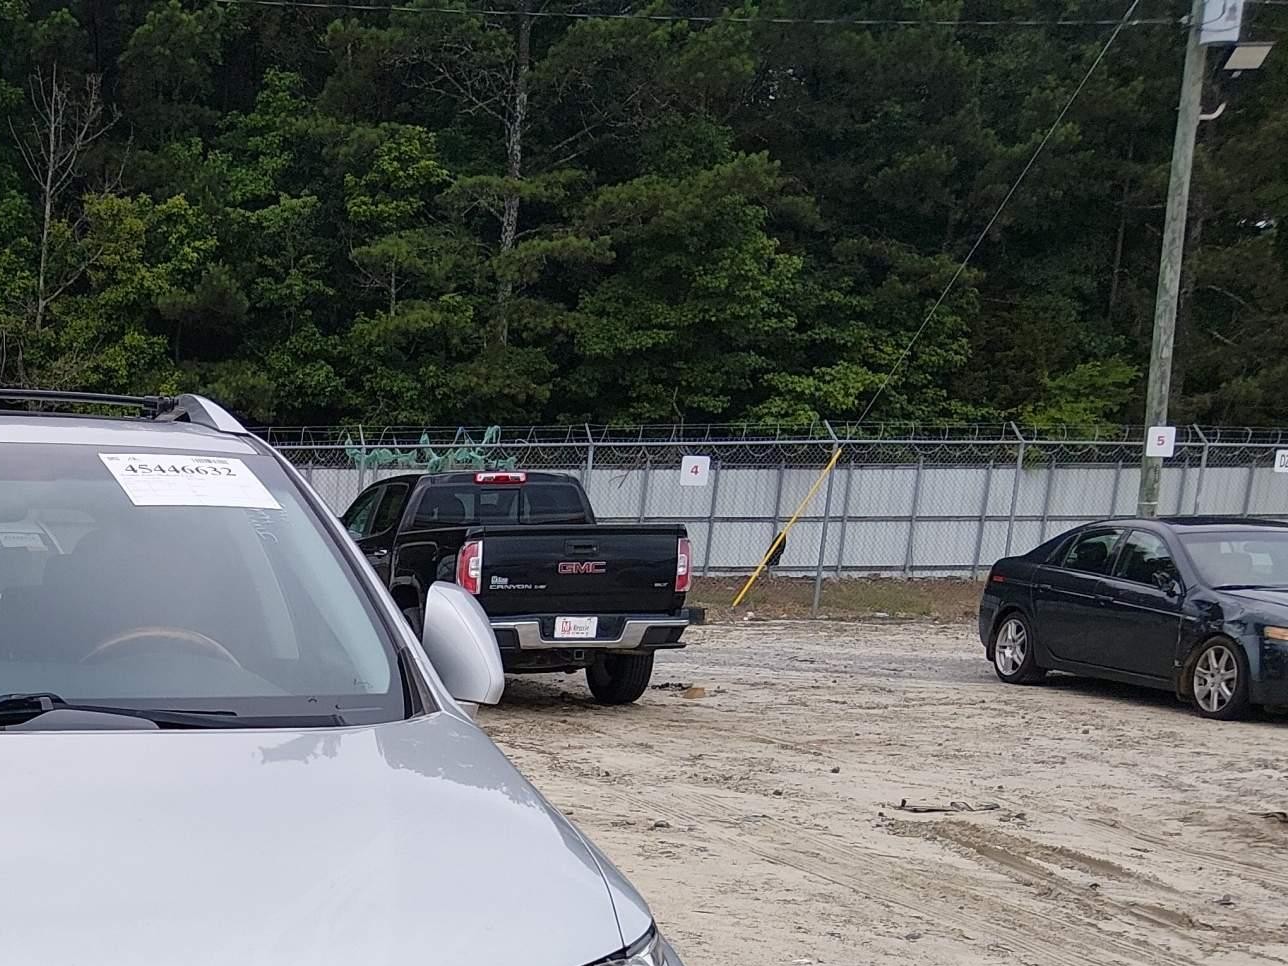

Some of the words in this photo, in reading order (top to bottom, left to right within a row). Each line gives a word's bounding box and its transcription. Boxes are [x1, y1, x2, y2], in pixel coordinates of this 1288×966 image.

[1157, 435, 1165, 446] 5
[125, 464, 237, 477] 45446632
[690, 465, 699, 475] 4
[558, 561, 607, 574] GMC
